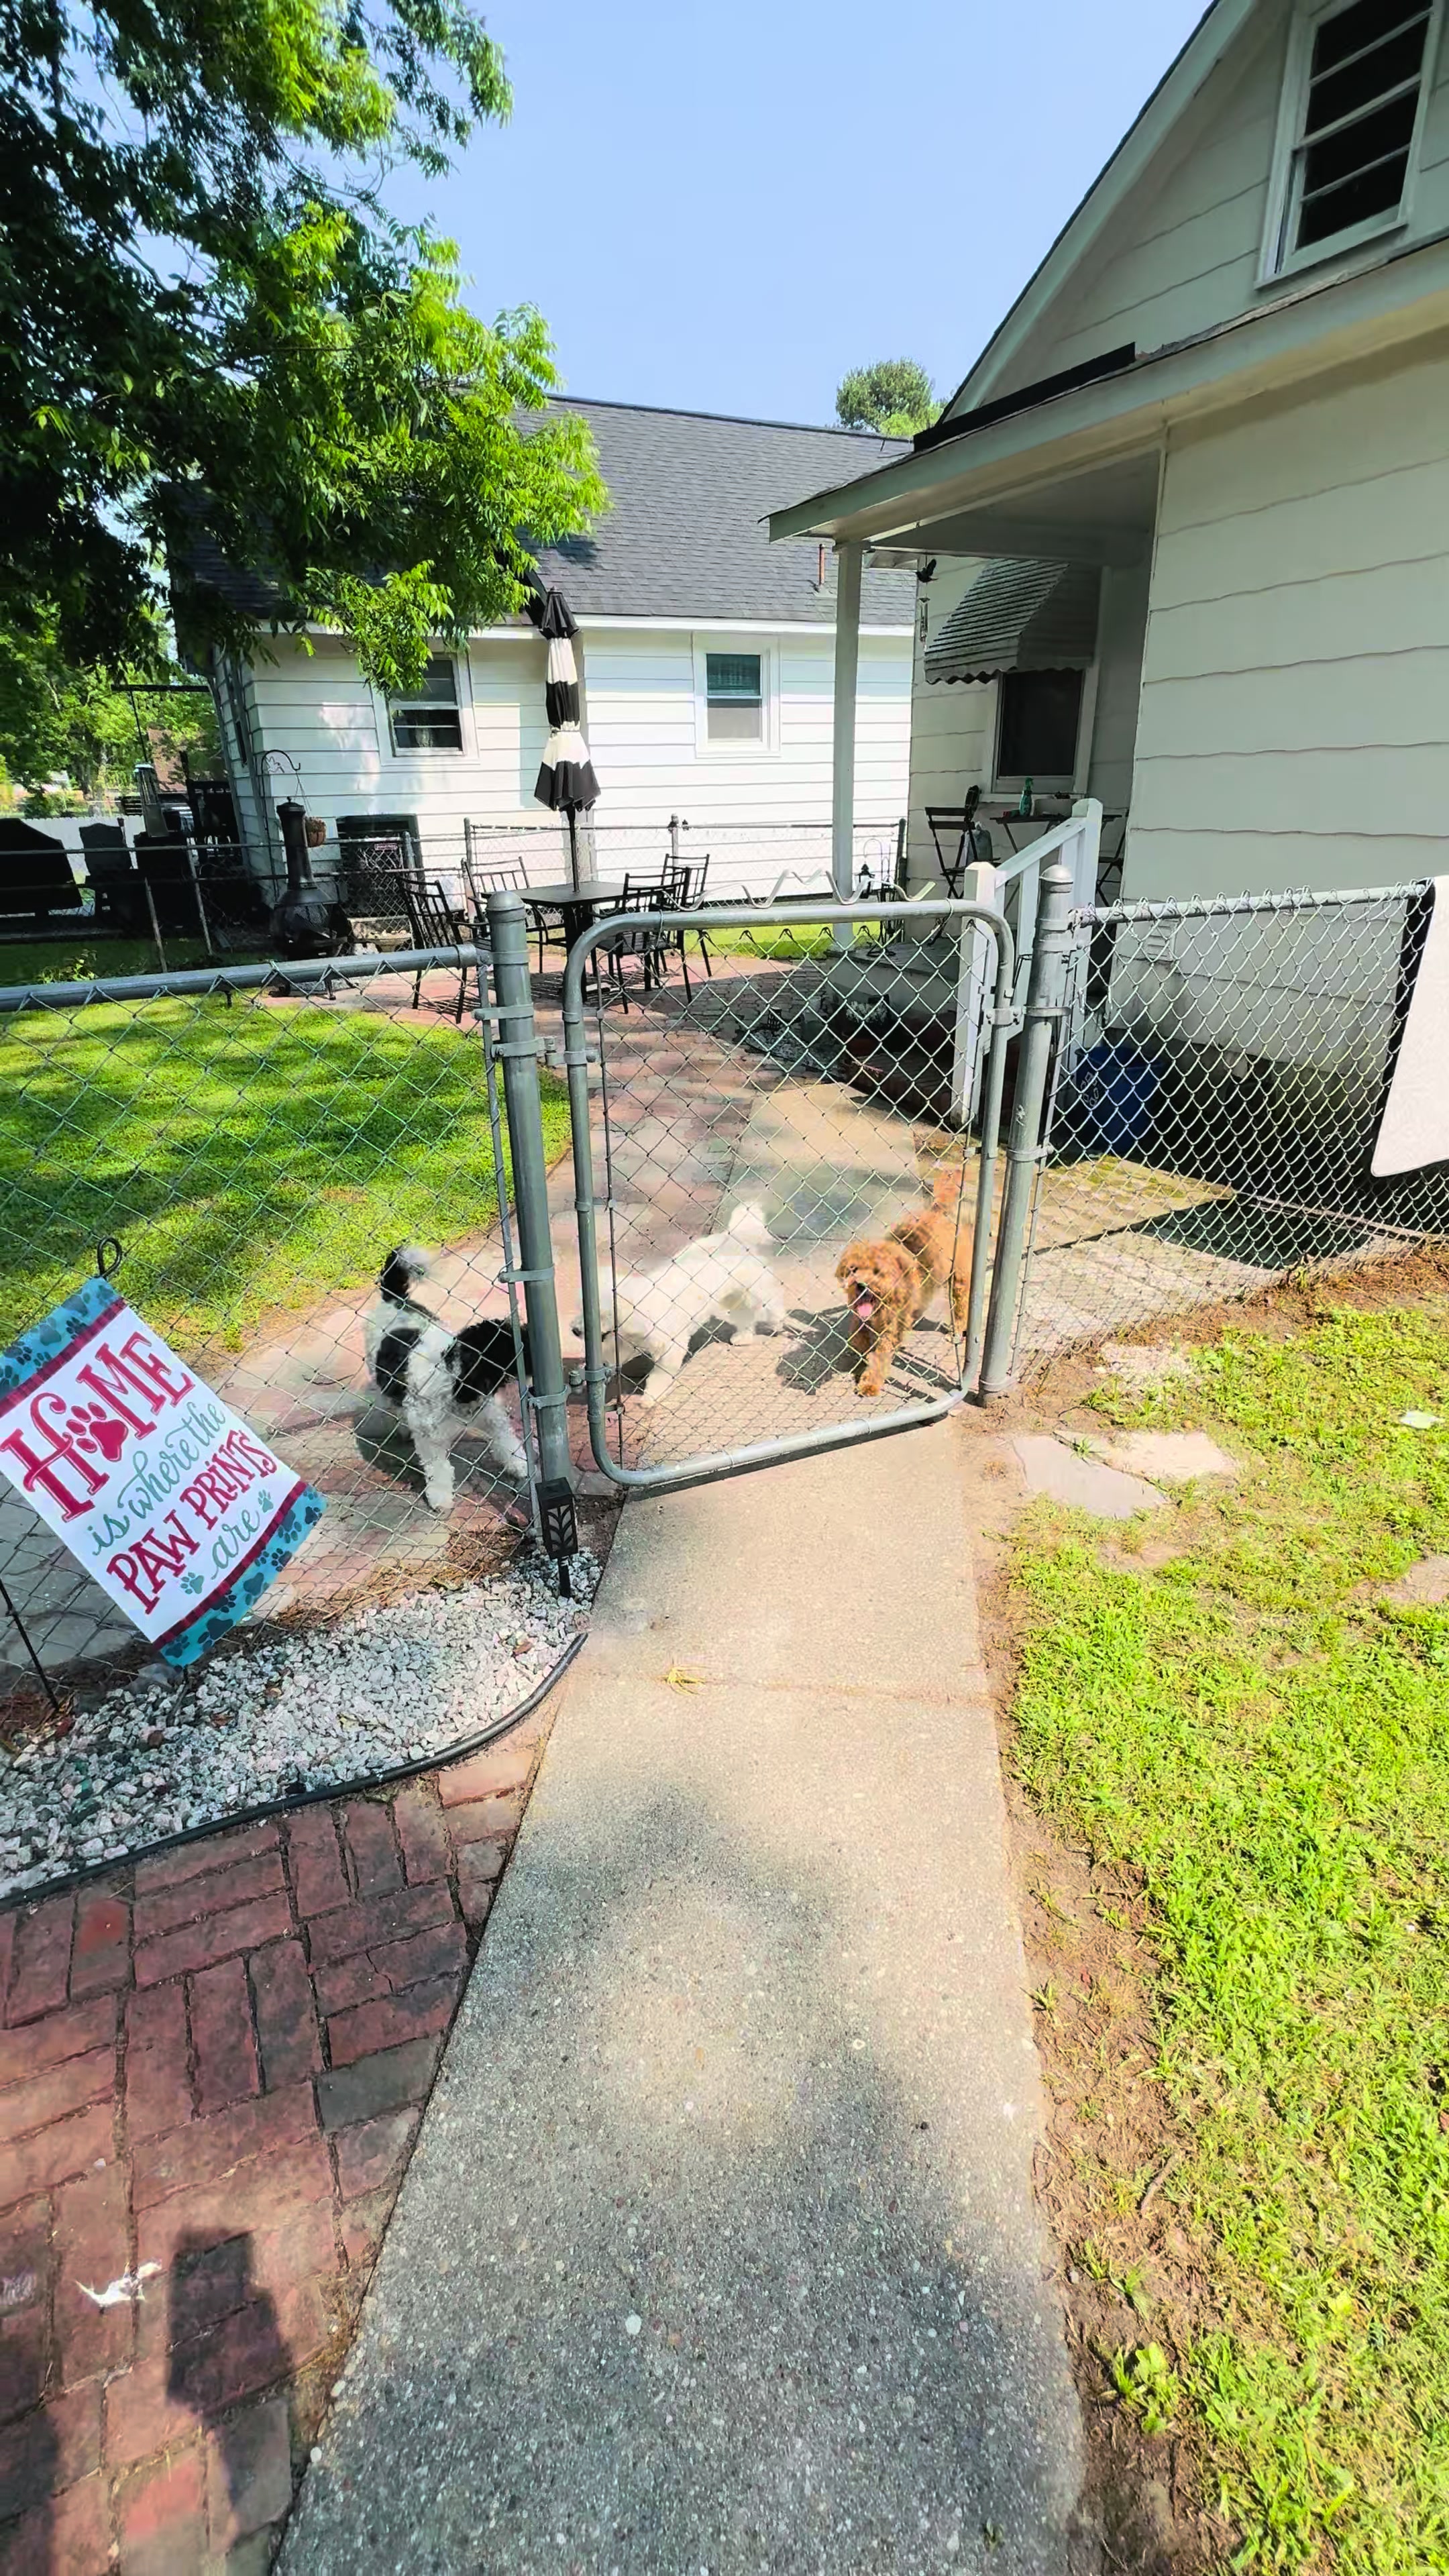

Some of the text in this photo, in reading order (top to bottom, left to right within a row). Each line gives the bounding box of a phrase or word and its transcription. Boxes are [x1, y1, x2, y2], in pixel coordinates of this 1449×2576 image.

[87, 1401, 225, 1556] is where the
[106, 1509, 201, 1614] PAW
[211, 1509, 260, 1580] are
